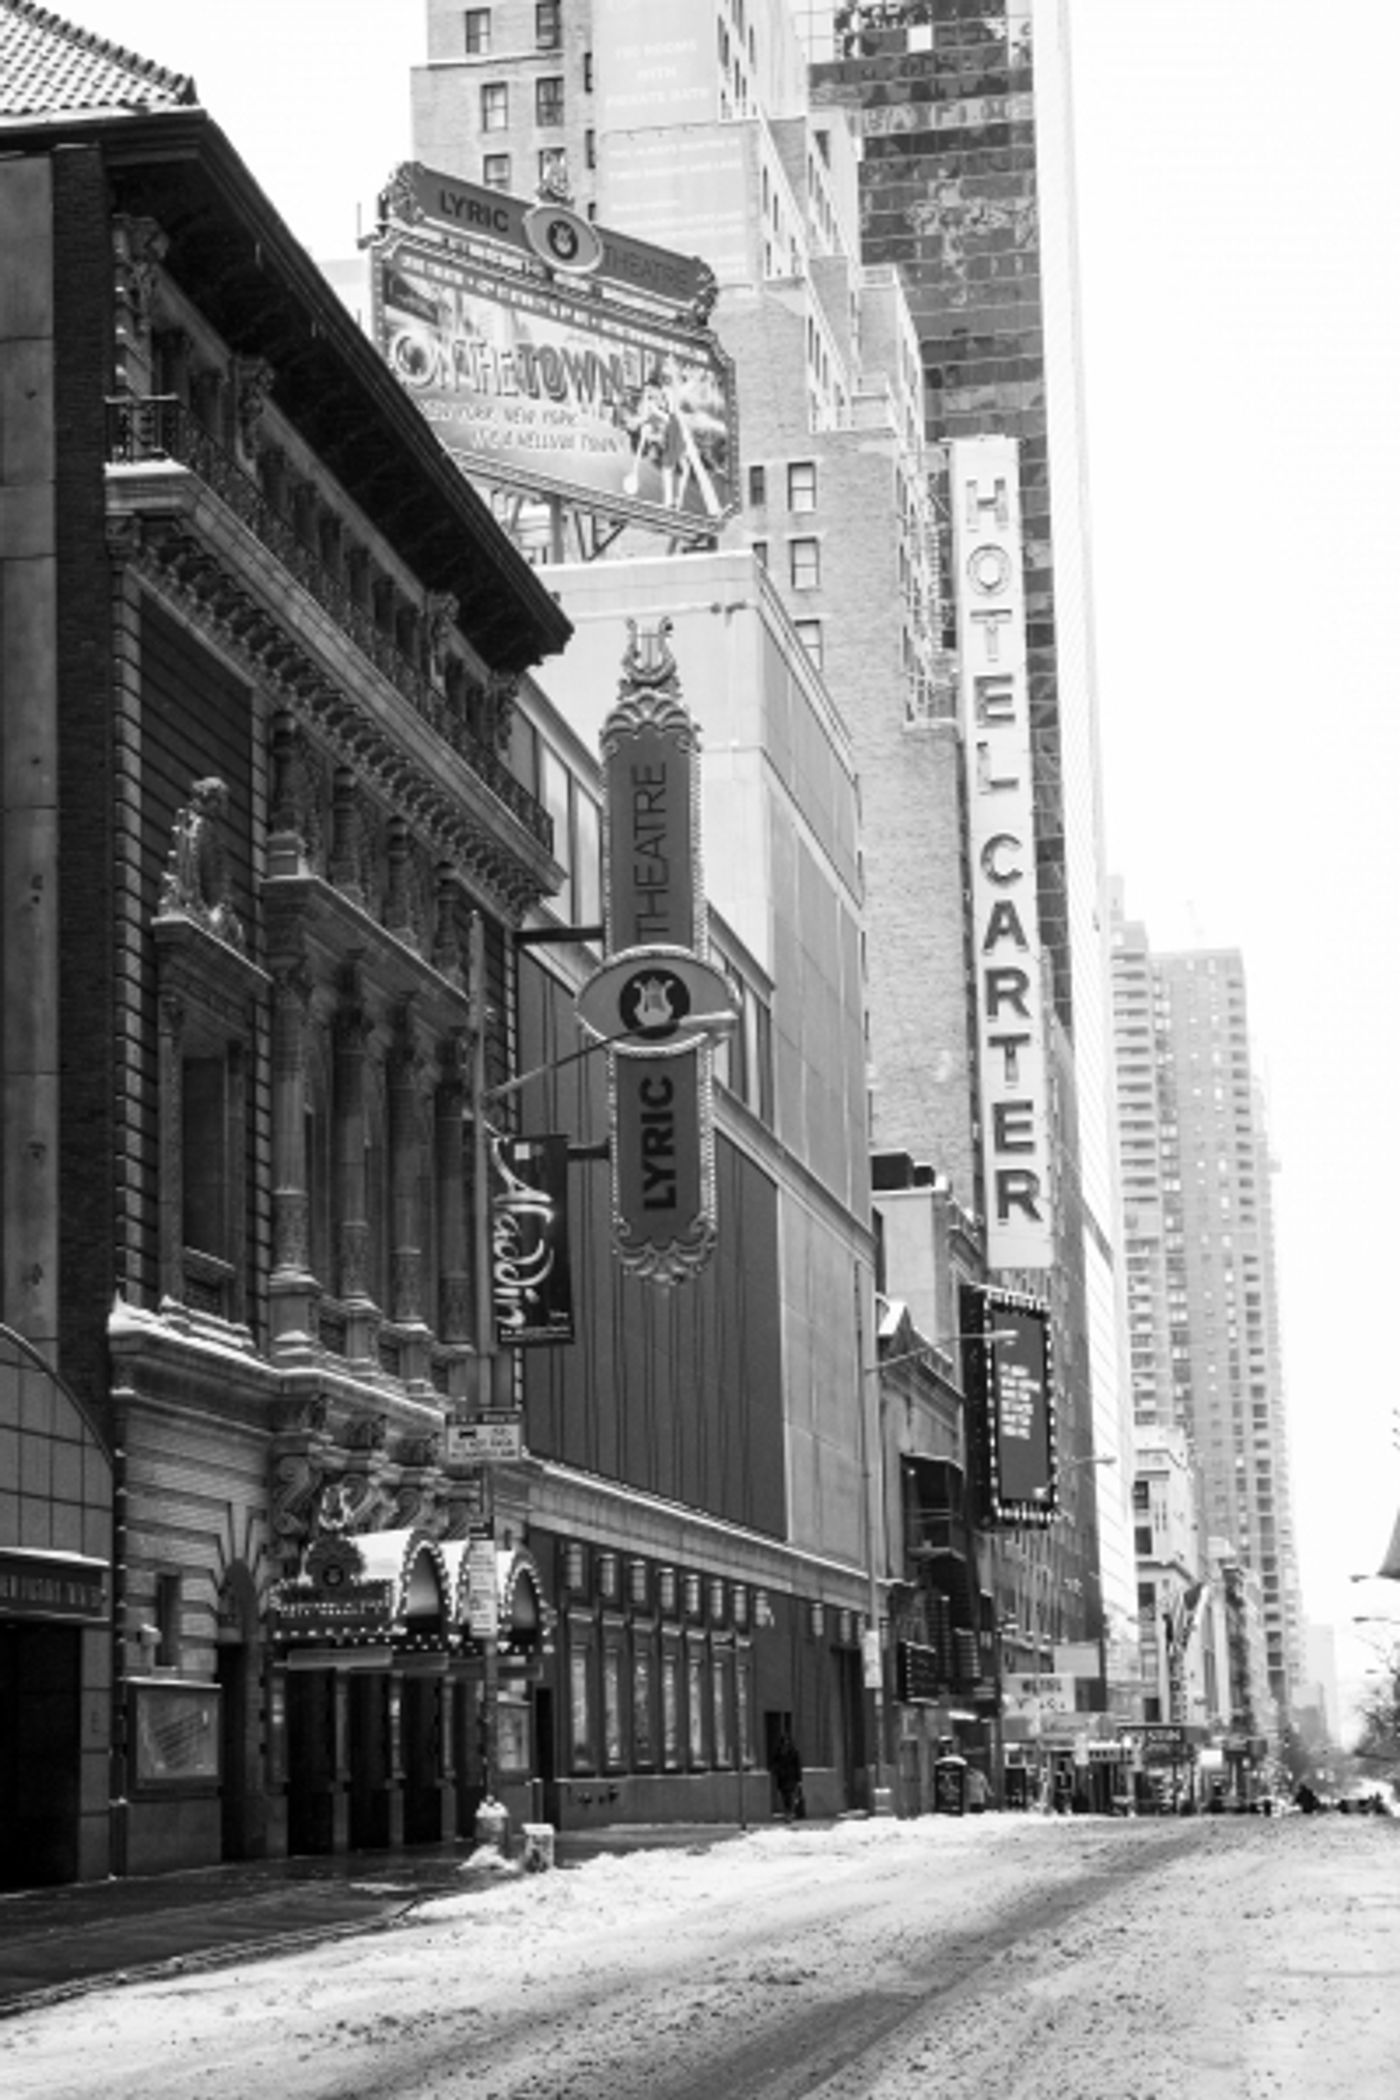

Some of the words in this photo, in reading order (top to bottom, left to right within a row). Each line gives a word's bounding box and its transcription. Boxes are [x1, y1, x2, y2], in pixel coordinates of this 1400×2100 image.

[438, 188, 511, 233] LYRIC
[601, 244, 690, 288] THEATRE
[517, 342, 624, 404] TOWN
[965, 477, 1021, 797] HOTEL
[631, 761, 669, 944] THEATRE
[979, 832, 1043, 1226] CARTER
[492, 1136, 555, 1327] Aladdin
[639, 1074, 677, 1211] LYRIC
